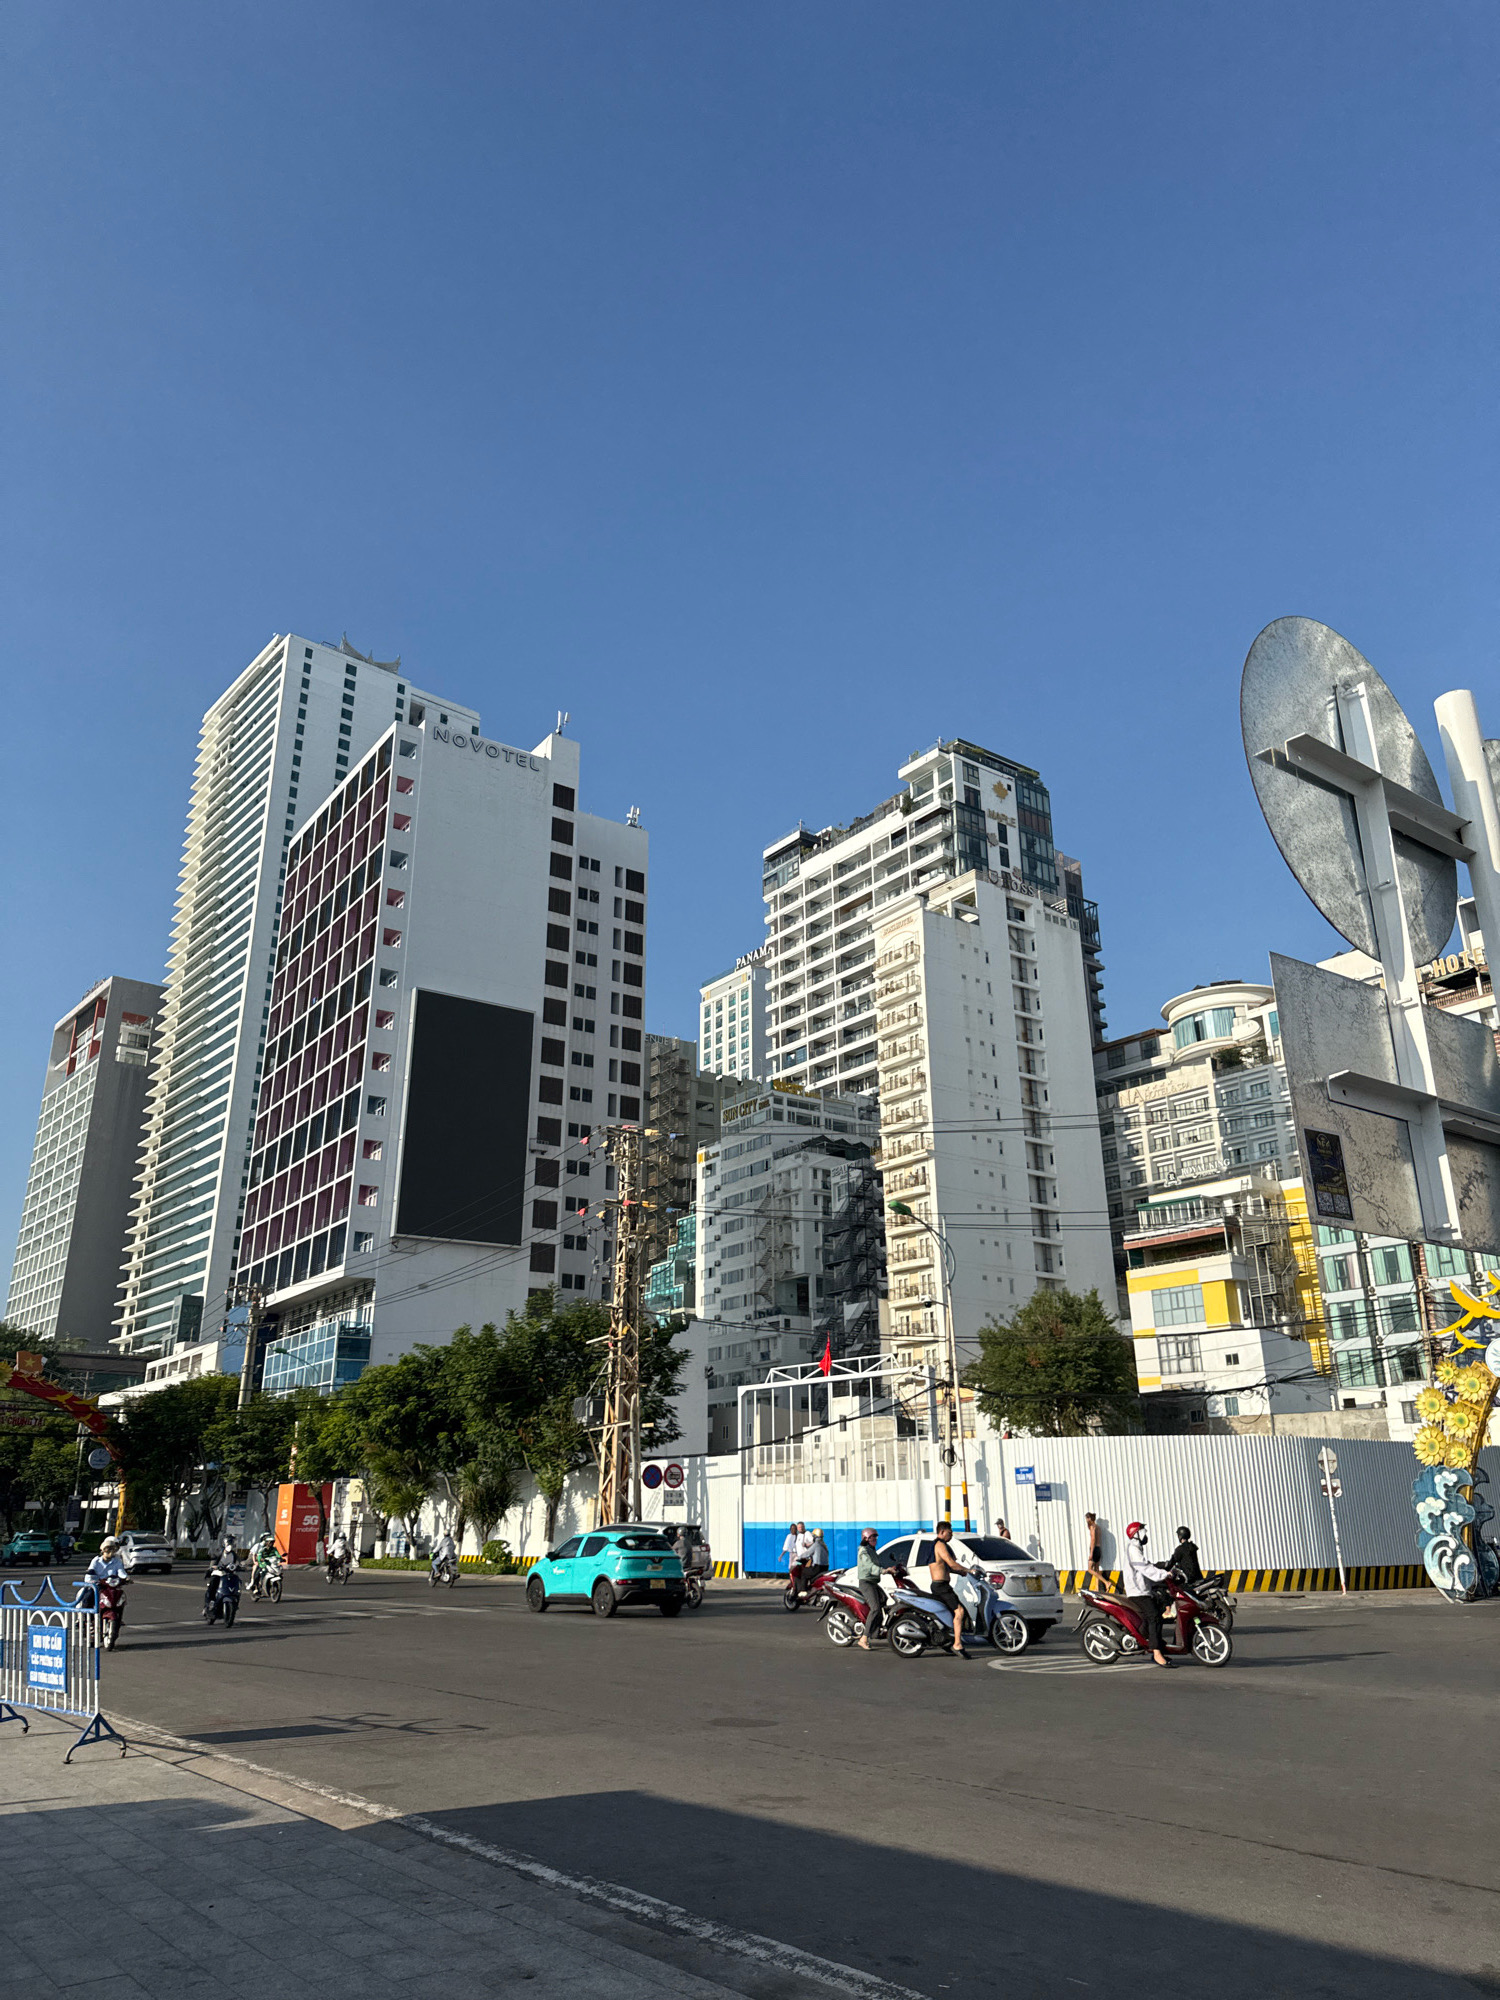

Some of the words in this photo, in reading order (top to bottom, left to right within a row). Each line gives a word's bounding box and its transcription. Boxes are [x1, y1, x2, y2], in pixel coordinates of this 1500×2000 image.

[433, 725, 540, 772] NOVOTEL
[723, 1105, 738, 1123] SUN
[739, 1098, 758, 1117] CITY
[1208, 1158, 1230, 1171] KING
[303, 1515, 319, 1526] 5G
